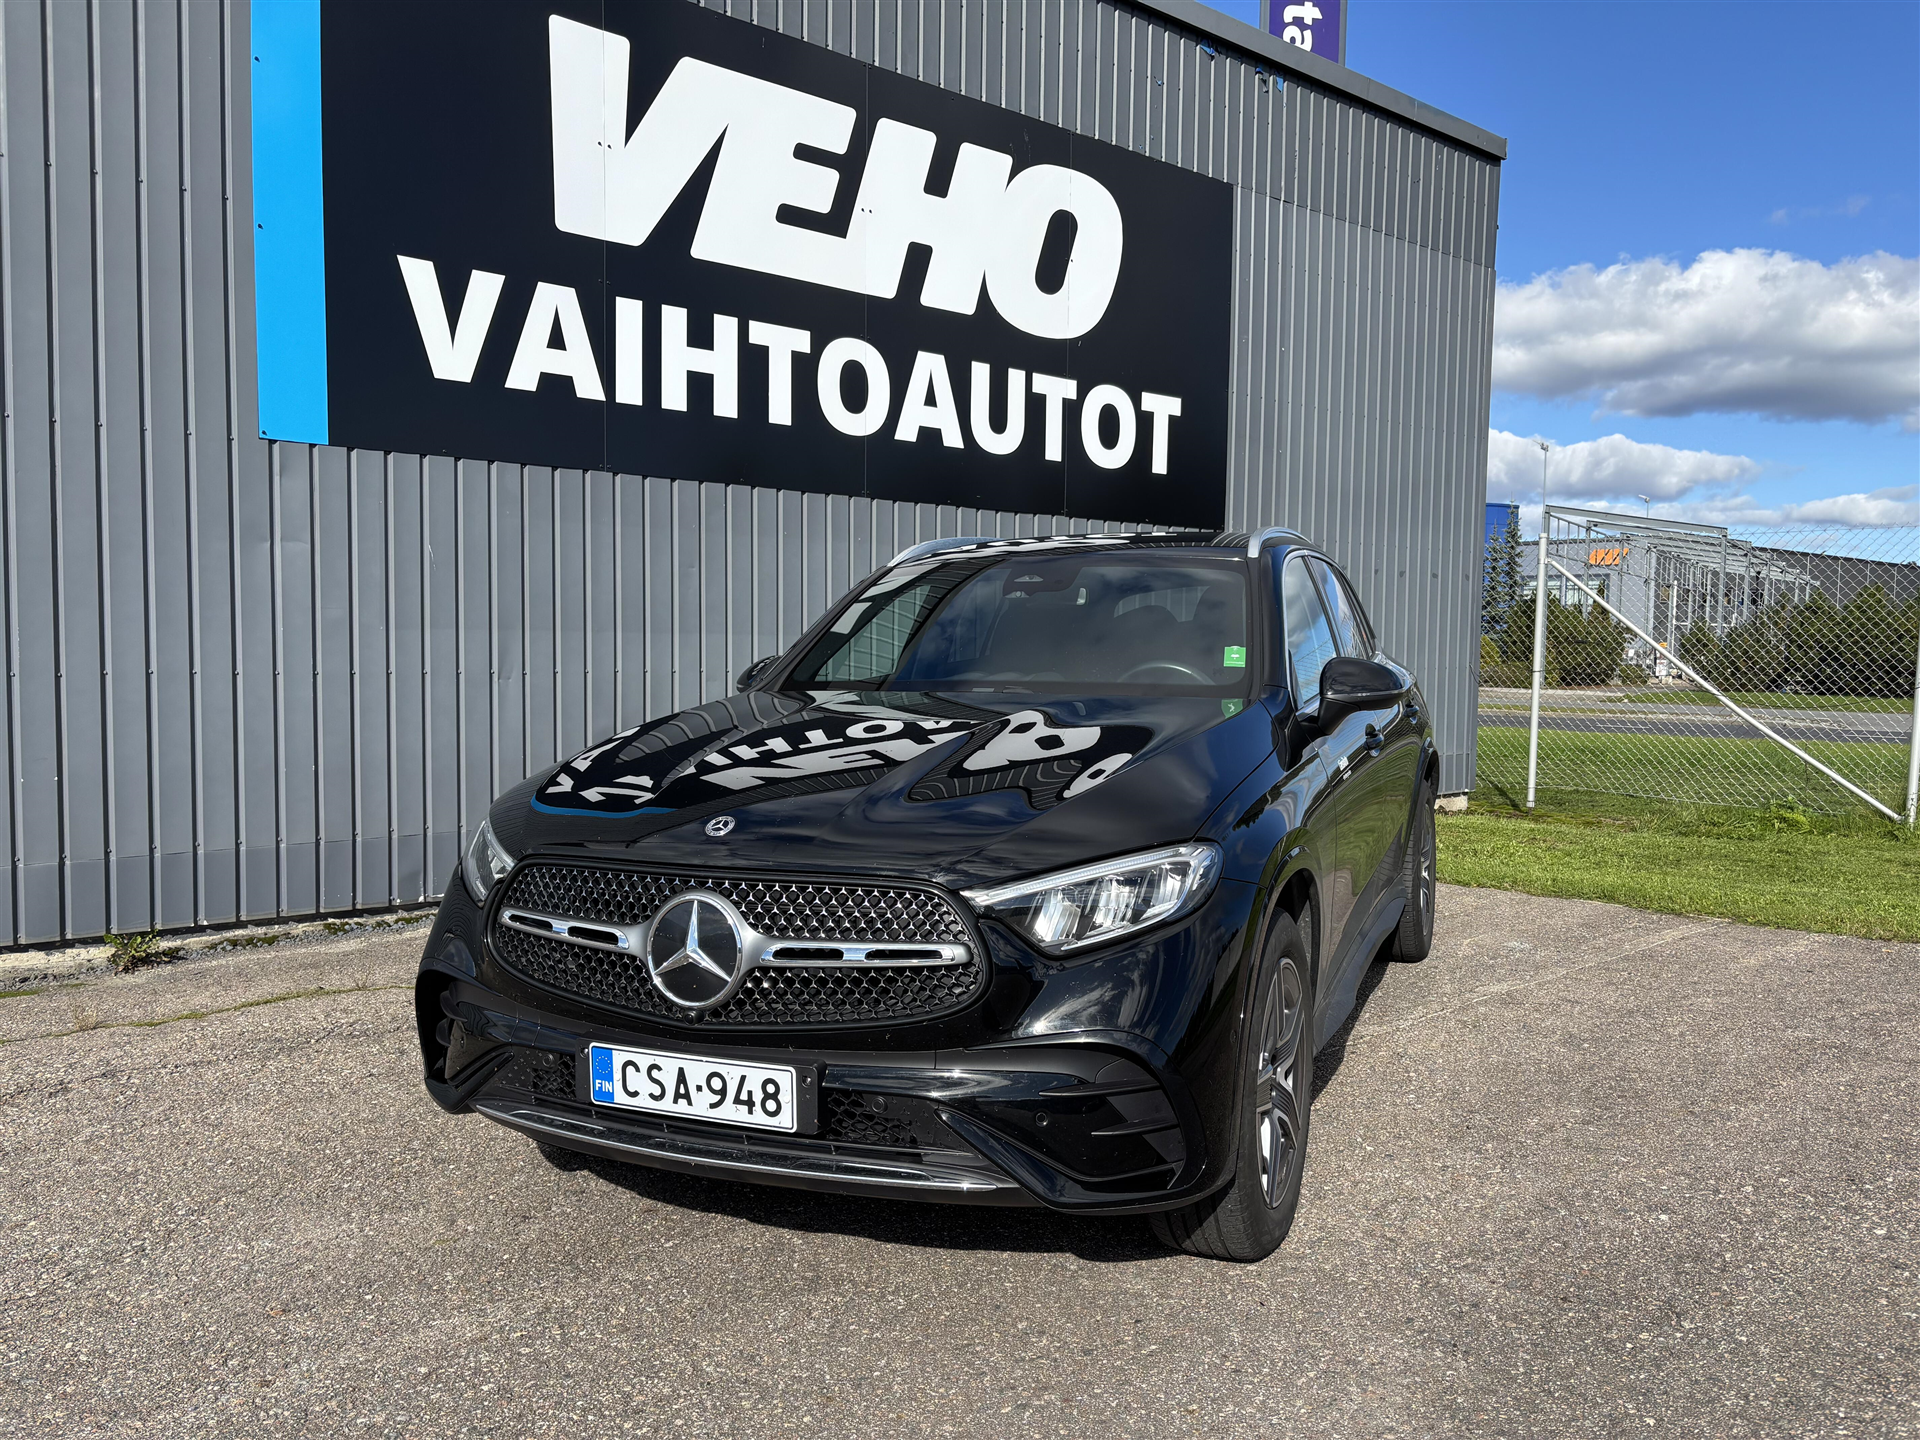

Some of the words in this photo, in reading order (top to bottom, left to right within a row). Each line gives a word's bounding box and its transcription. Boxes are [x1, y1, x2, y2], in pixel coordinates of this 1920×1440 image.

[548, 13, 1124, 340] VEHO
[396, 254, 1182, 475] VAIHTOAUTOT
[595, 1079, 613, 1093] FIN
[621, 1059, 782, 1118] CSA-948
